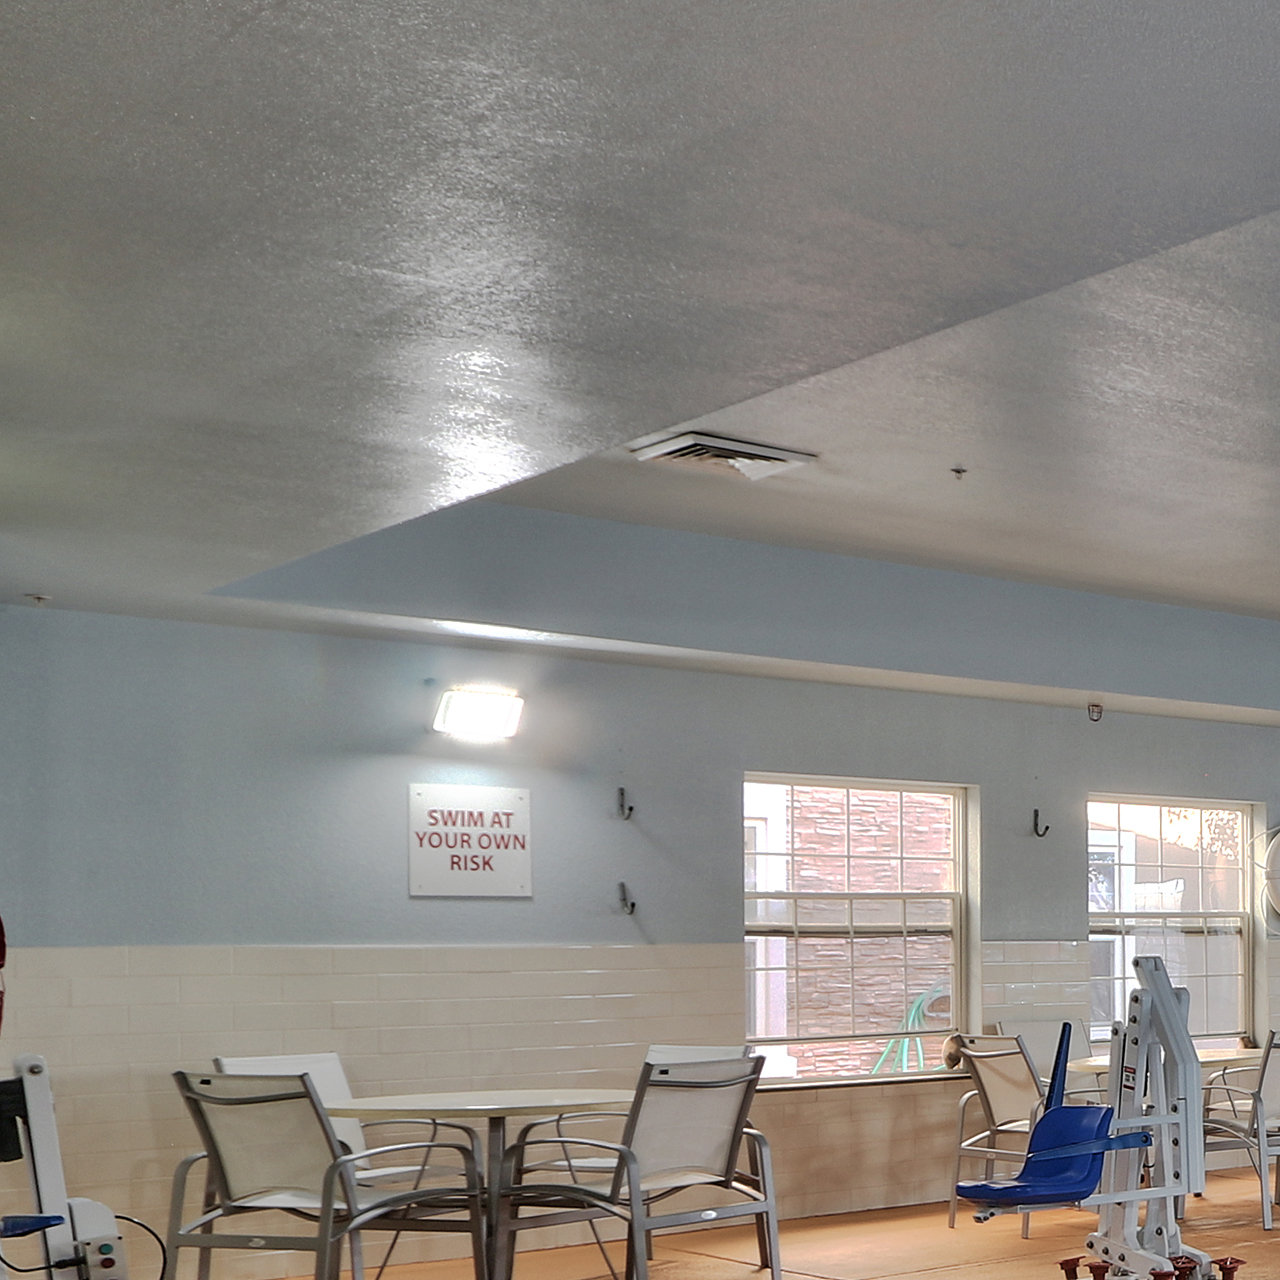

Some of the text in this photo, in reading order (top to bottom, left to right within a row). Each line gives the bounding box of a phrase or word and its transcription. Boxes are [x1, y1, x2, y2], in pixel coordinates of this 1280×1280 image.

[427, 809, 515, 829] SWIM AT
[415, 831, 527, 850] YOUR OWN
[450, 854, 495, 871] RISK
